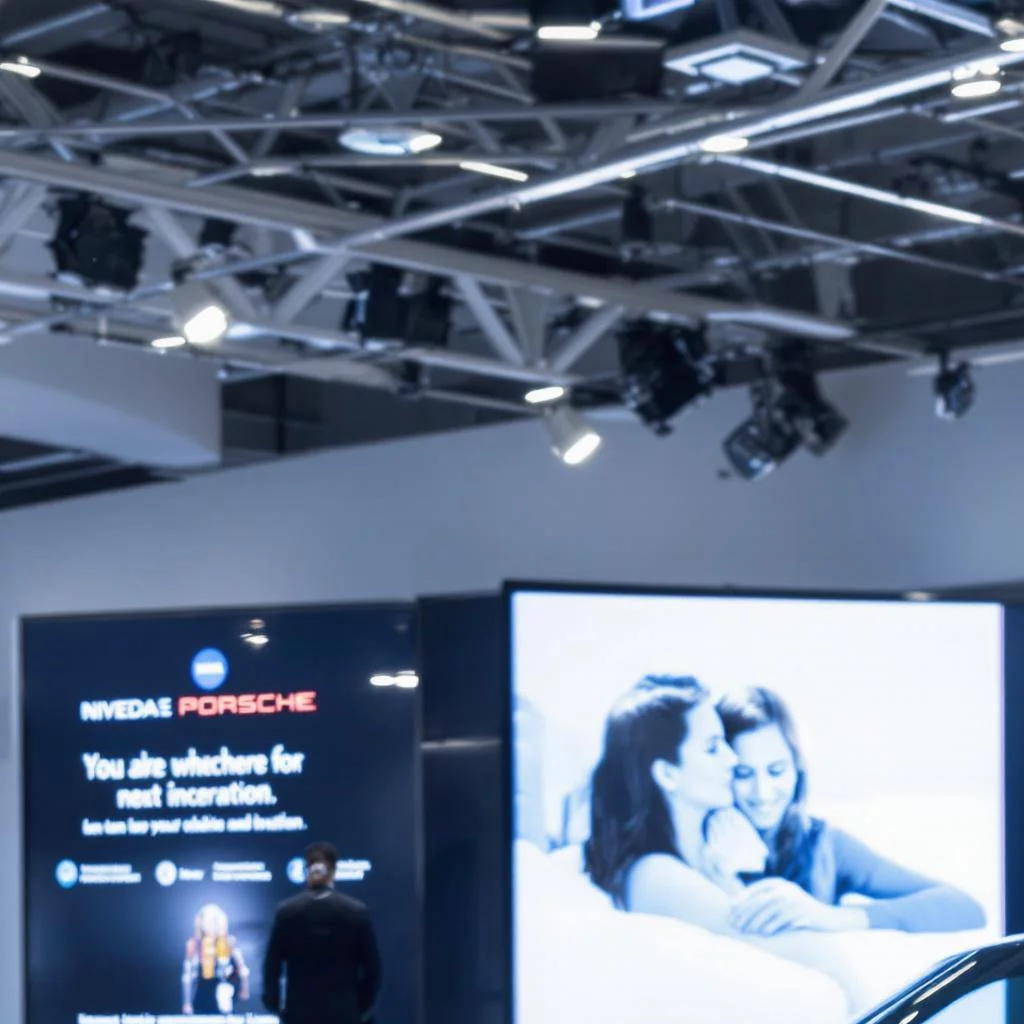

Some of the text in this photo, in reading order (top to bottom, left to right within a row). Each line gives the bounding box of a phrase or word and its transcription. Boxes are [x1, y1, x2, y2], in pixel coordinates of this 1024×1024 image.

[178, 691, 316, 716] PORSCHE
[83, 753, 124, 780] You
[271, 745, 304, 774] for
